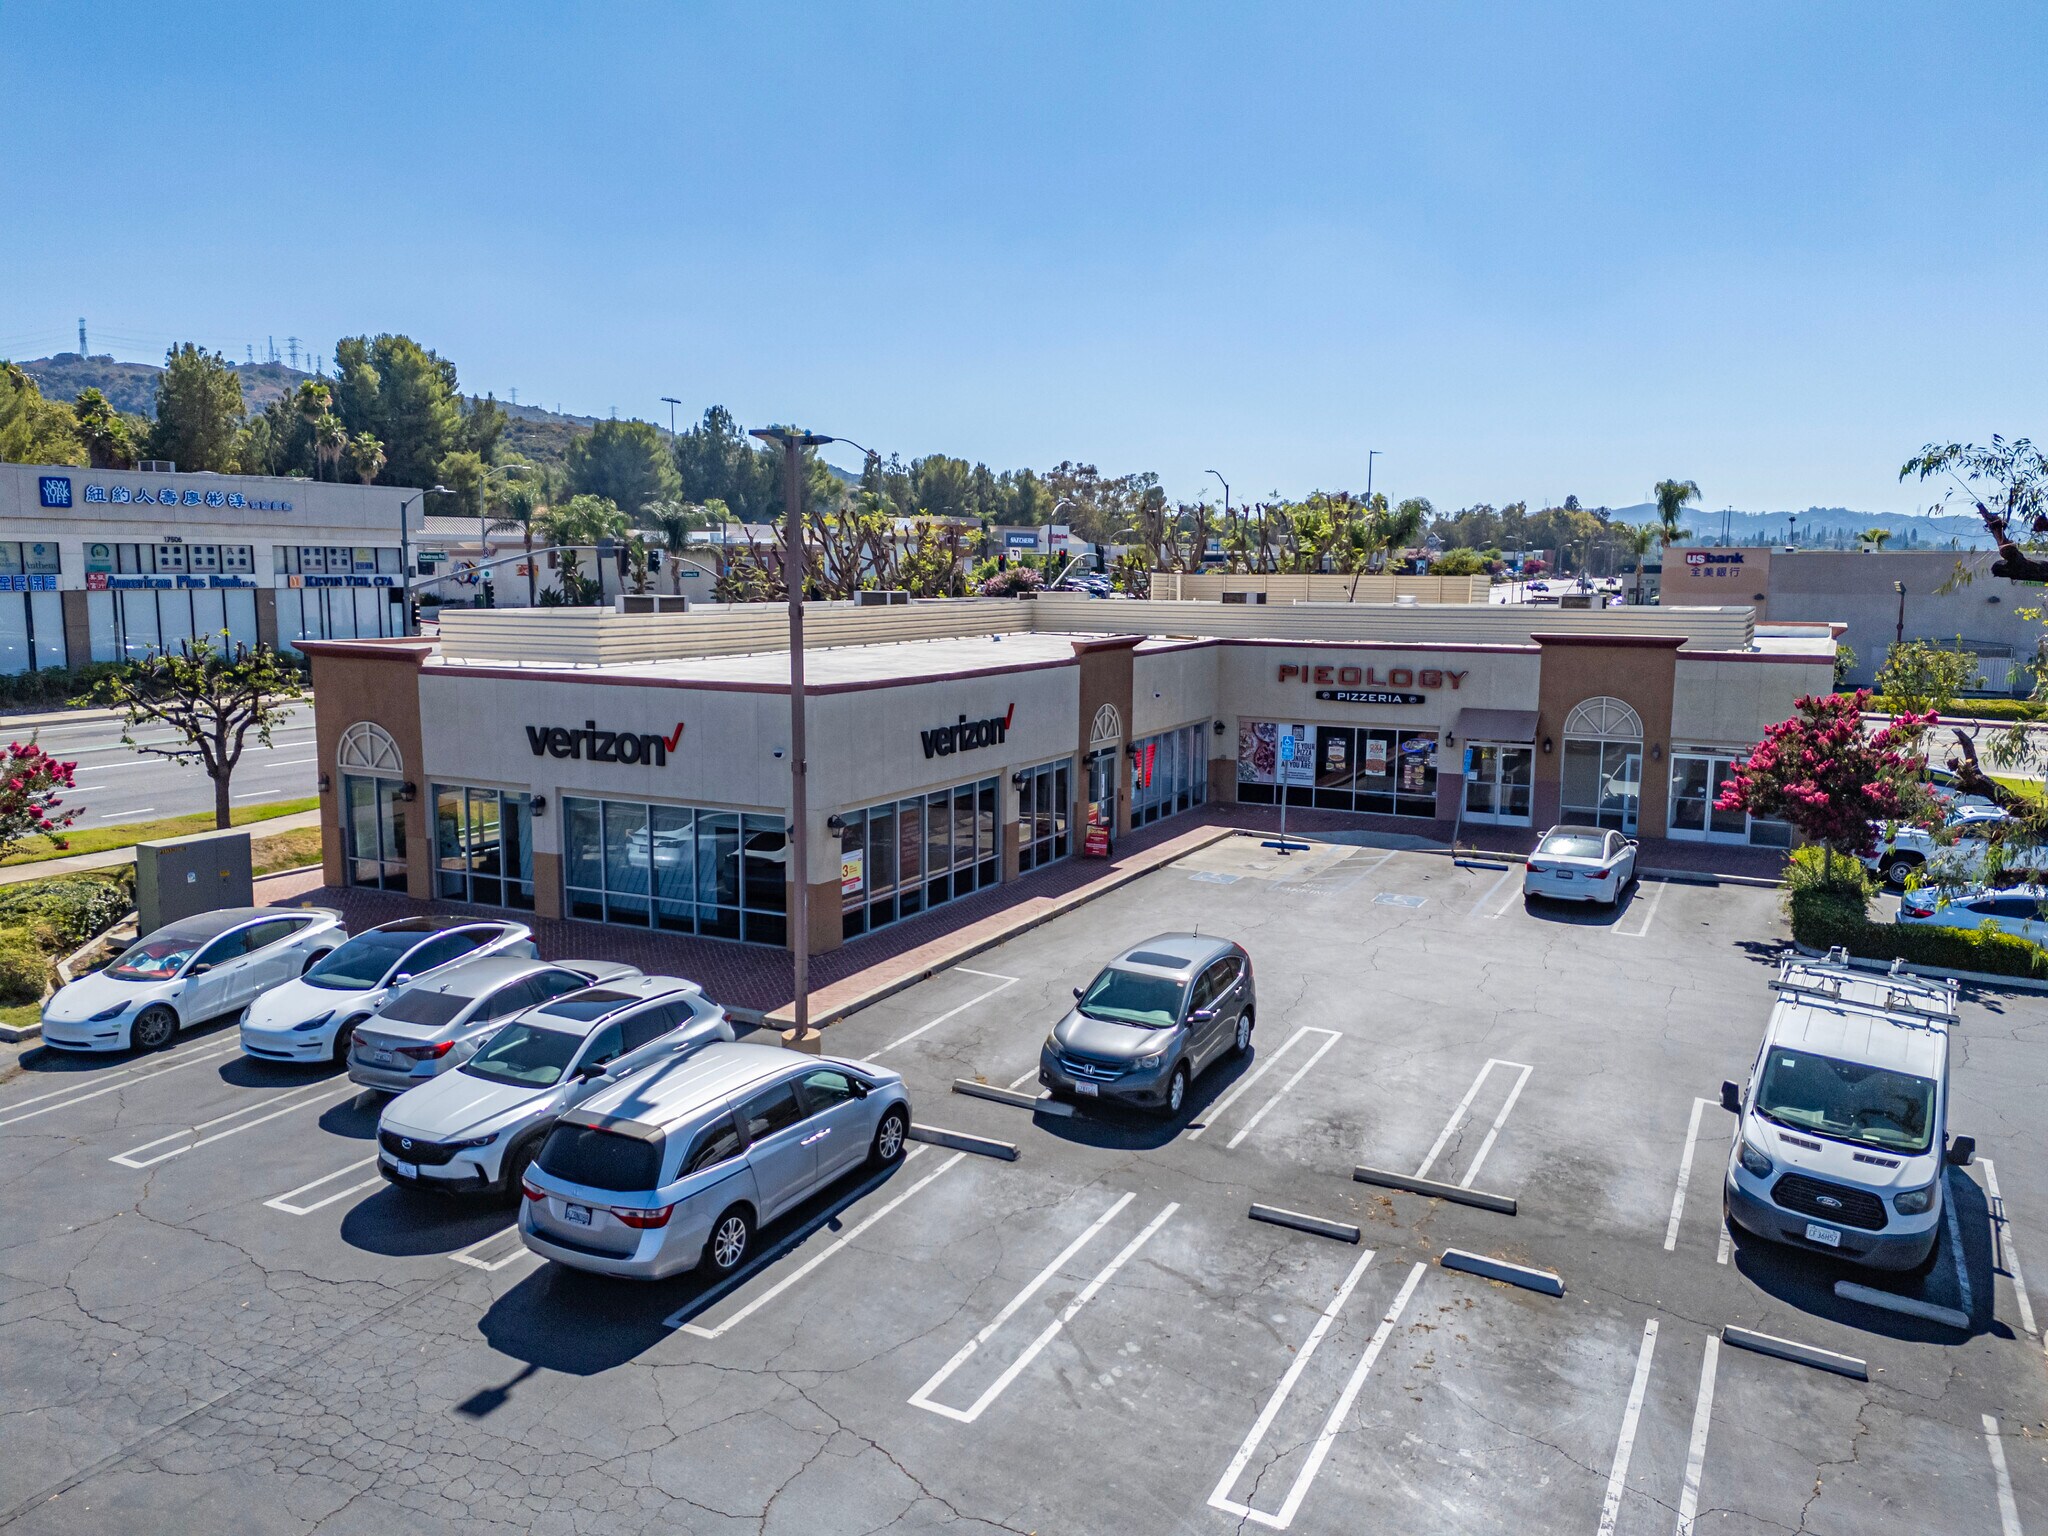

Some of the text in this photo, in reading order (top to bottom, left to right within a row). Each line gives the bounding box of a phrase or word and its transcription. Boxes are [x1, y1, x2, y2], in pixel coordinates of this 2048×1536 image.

[46, 480, 67, 489] NEW
[43, 487, 70, 496] YORK
[47, 494, 68, 504] LIFE
[26, 561, 57, 569] Anthem
[1690, 567, 1740, 578] 全美銀行
[107, 575, 172, 588] American
[176, 575, 206, 588] Plus
[209, 575, 241, 588] Bank
[305, 576, 342, 587] KEVIN
[374, 577, 394, 586] CPA
[1278, 664, 1469, 690] PIEOLOGY
[1337, 692, 1402, 703] PIZZERIA
[921, 714, 1006, 759] verizon
[525, 720, 666, 766] verizon
